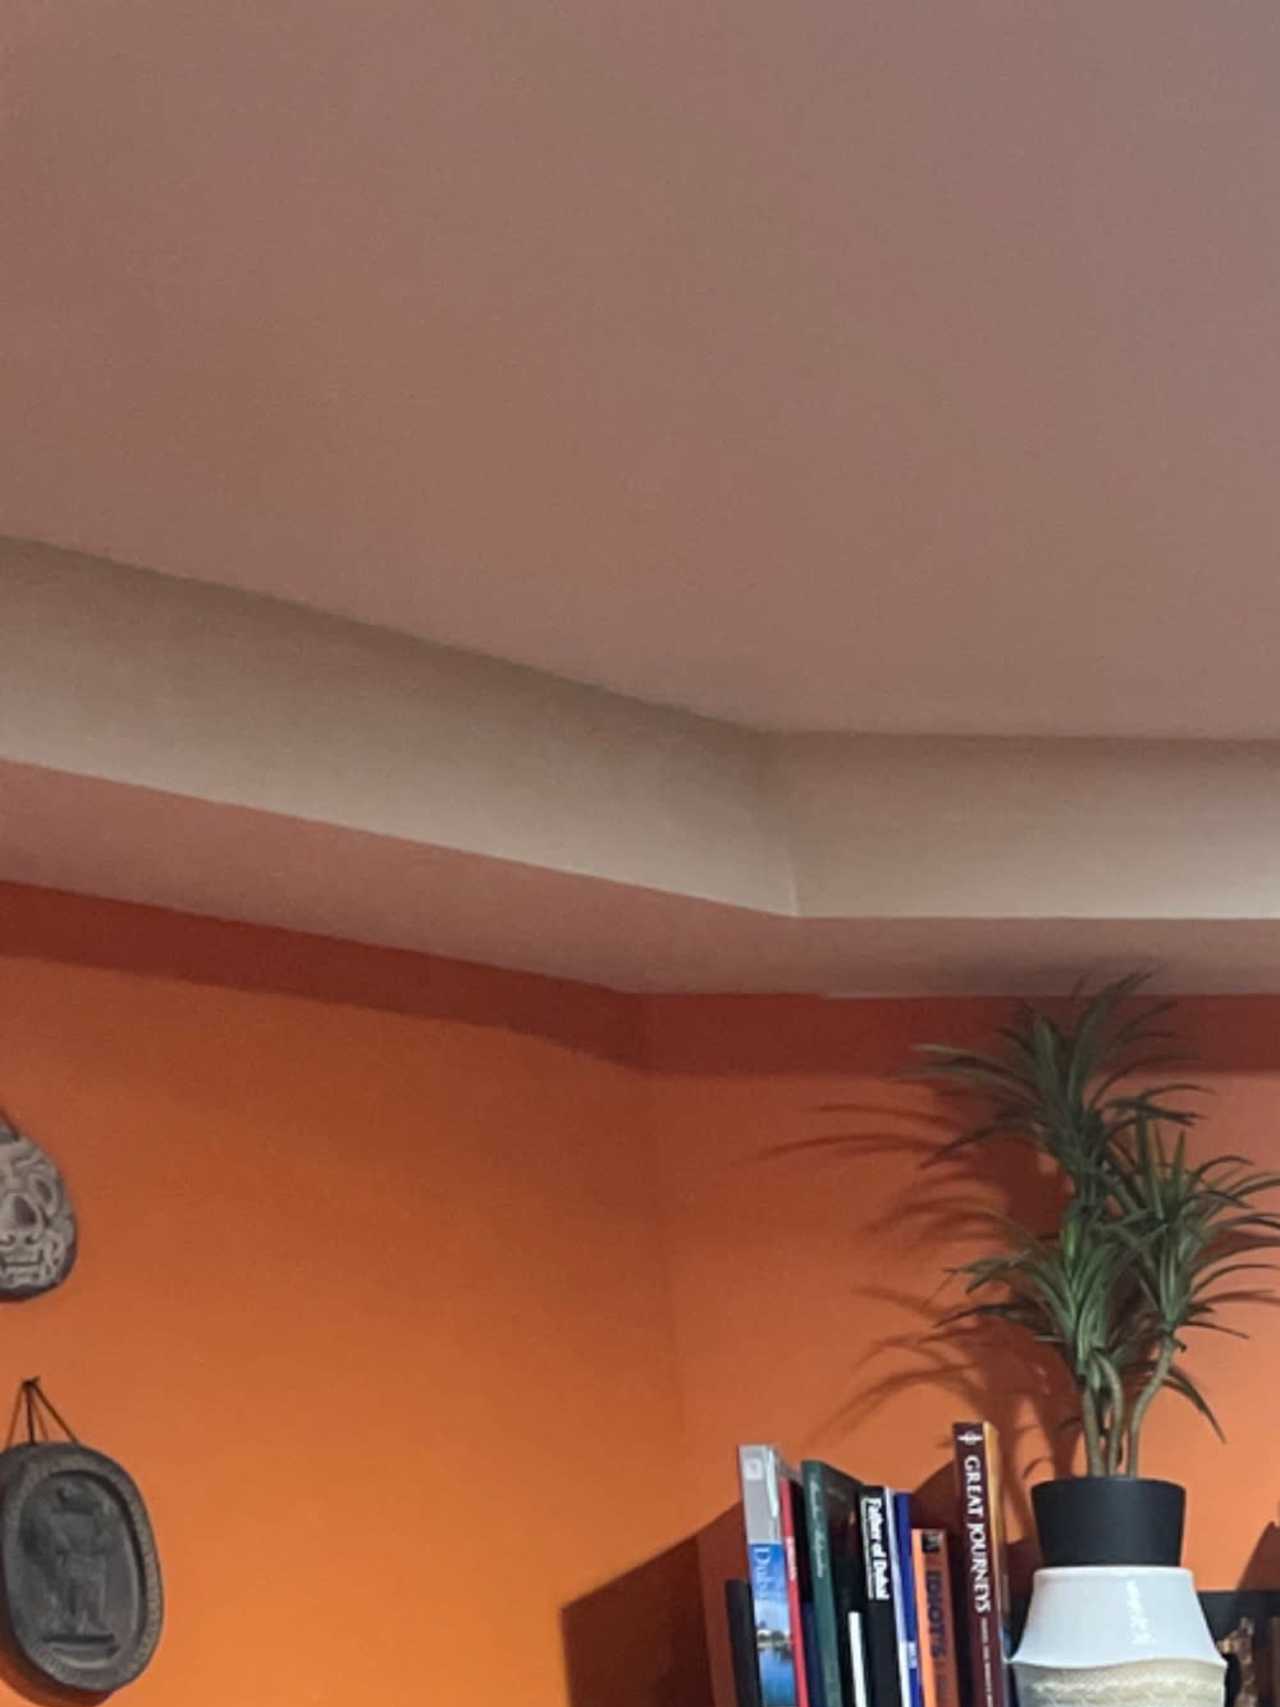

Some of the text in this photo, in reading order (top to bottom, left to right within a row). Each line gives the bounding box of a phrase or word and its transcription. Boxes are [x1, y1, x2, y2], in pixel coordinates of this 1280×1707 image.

[871, 1541, 886, 1557] of
[963, 1455, 991, 1612] GREAT JOURNEYS
